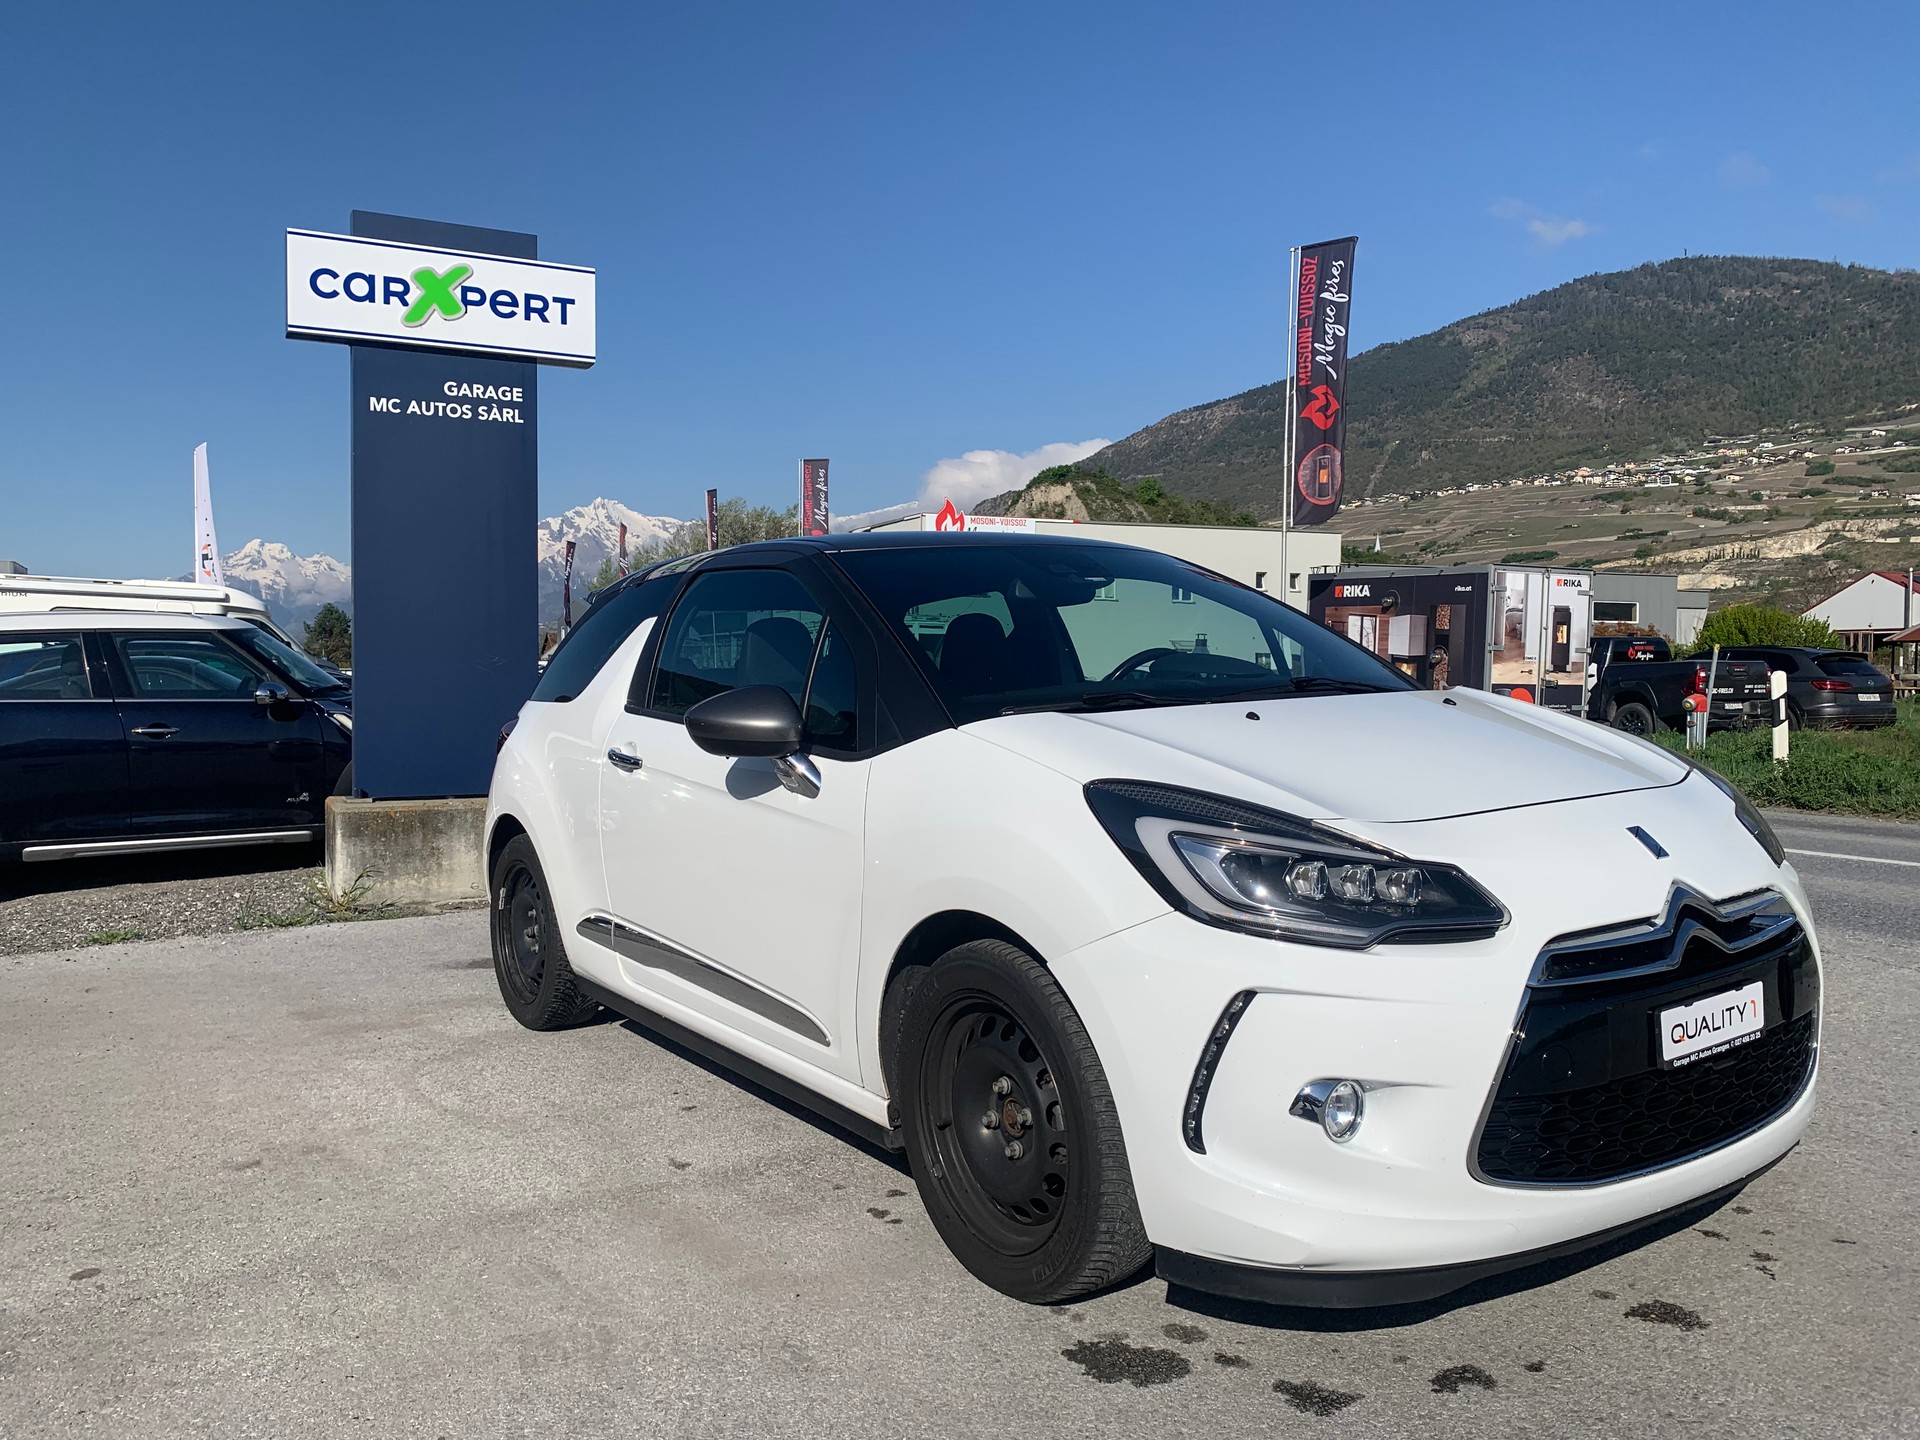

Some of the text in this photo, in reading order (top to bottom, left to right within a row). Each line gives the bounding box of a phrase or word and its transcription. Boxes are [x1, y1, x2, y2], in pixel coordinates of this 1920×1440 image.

[1298, 255, 1319, 386] MOSONI-VUISSOZ
[1313, 259, 1350, 381] Magic fires
[443, 381, 524, 403] GARAGE
[369, 396, 525, 424] MC AUTOS SÀRL
[970, 516, 1028, 527] MOSONI-VUISSOZ
[1343, 584, 1371, 598] RIKA
[1562, 579, 1583, 588] RIKA
[1673, 1056, 1690, 1068] Garage
[1690, 1052, 1699, 1062] MC
[1699, 1049, 1712, 1059] Autos
